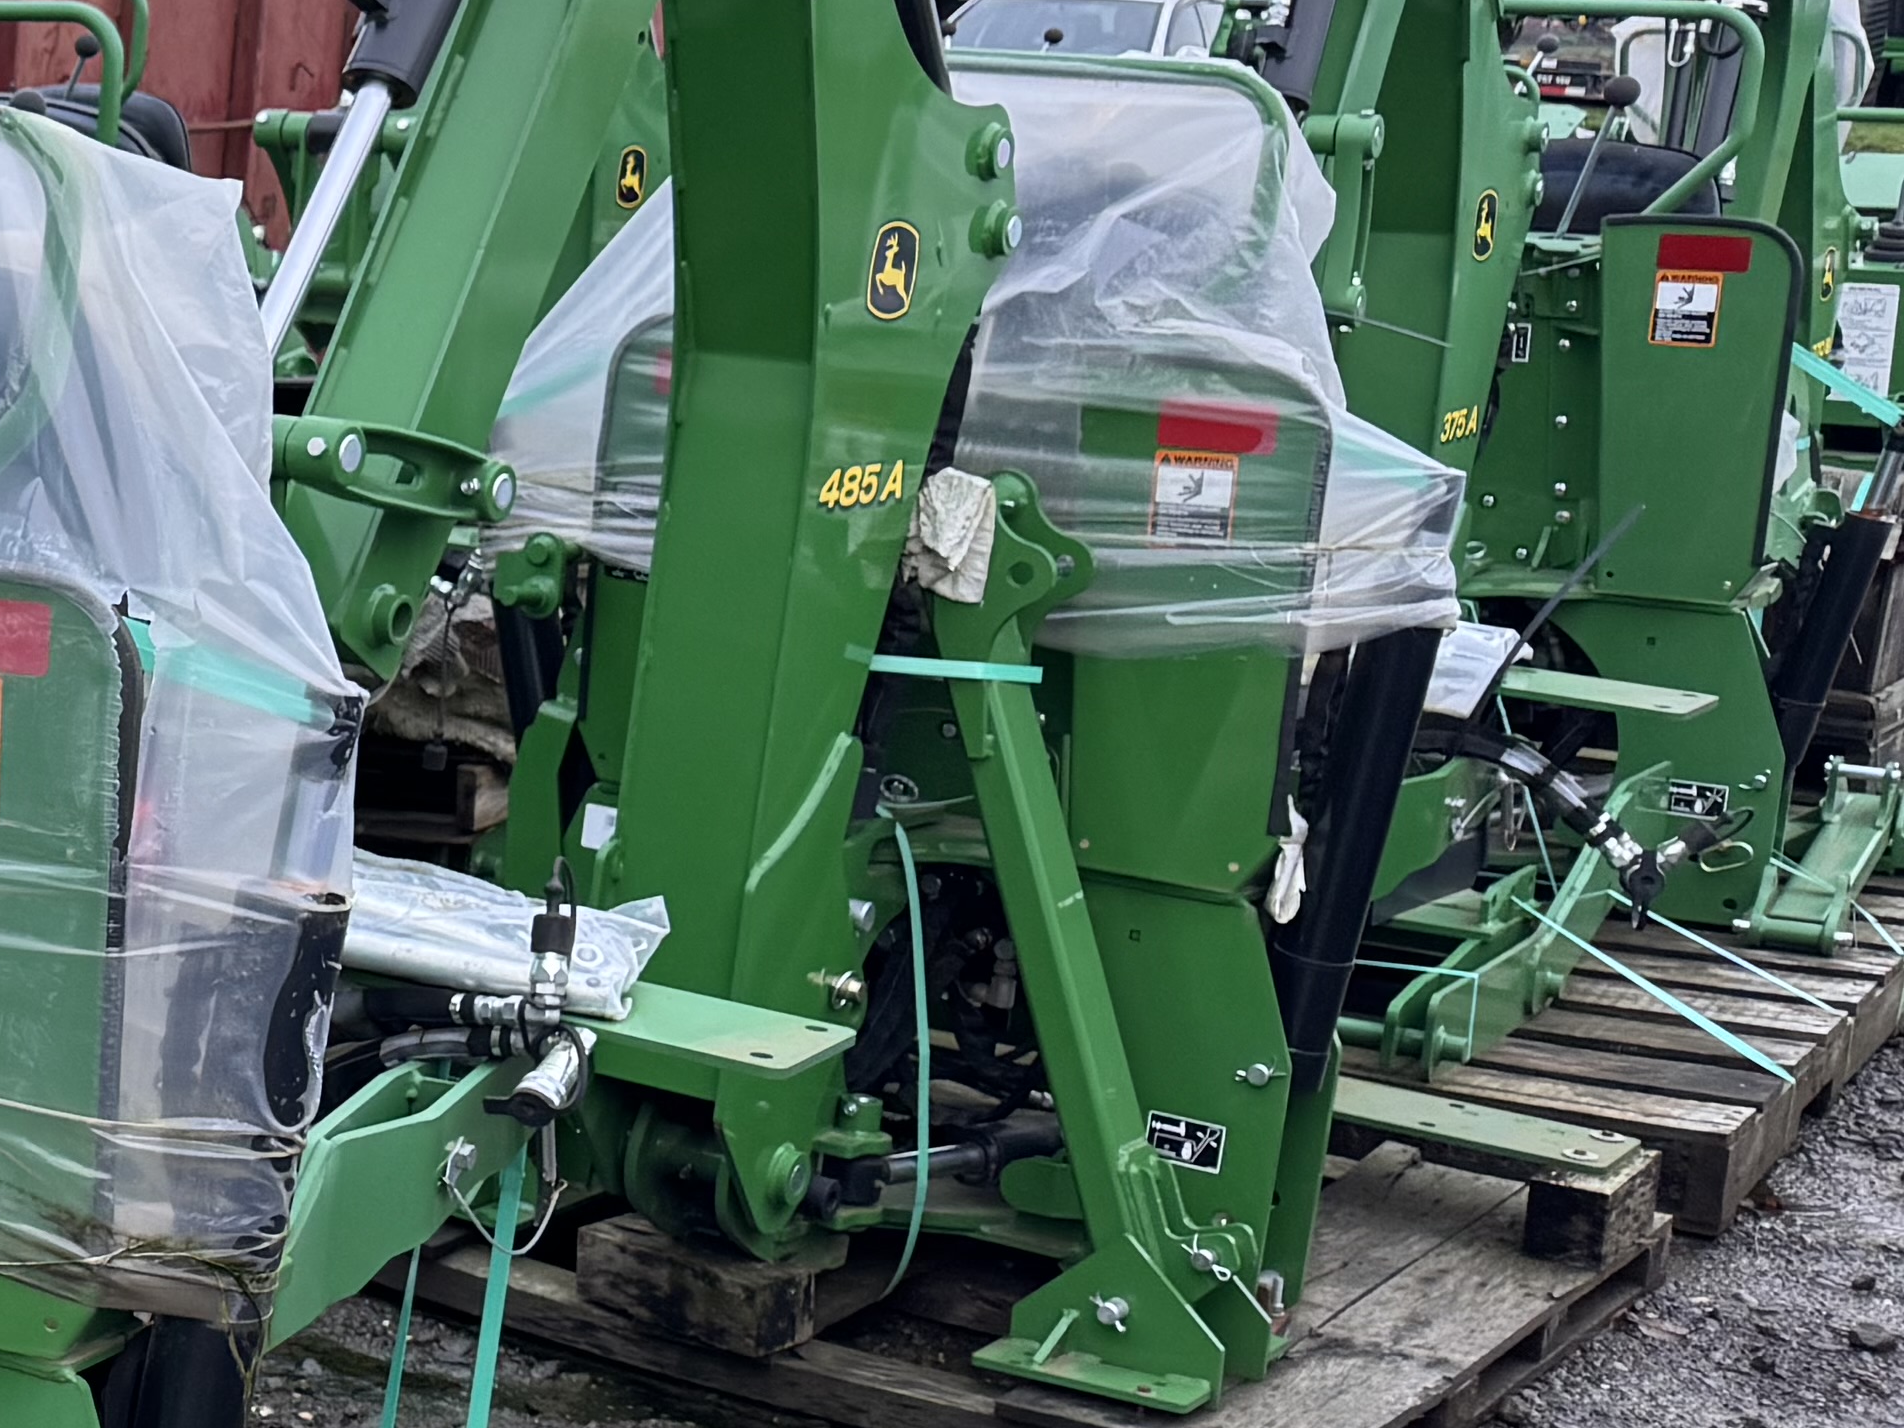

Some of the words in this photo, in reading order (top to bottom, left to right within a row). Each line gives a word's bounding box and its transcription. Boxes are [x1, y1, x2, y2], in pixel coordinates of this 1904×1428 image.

[1440, 408, 1468, 442] 375
[1465, 404, 1478, 435] A
[818, 463, 882, 509] 485
[879, 458, 904, 502] A
